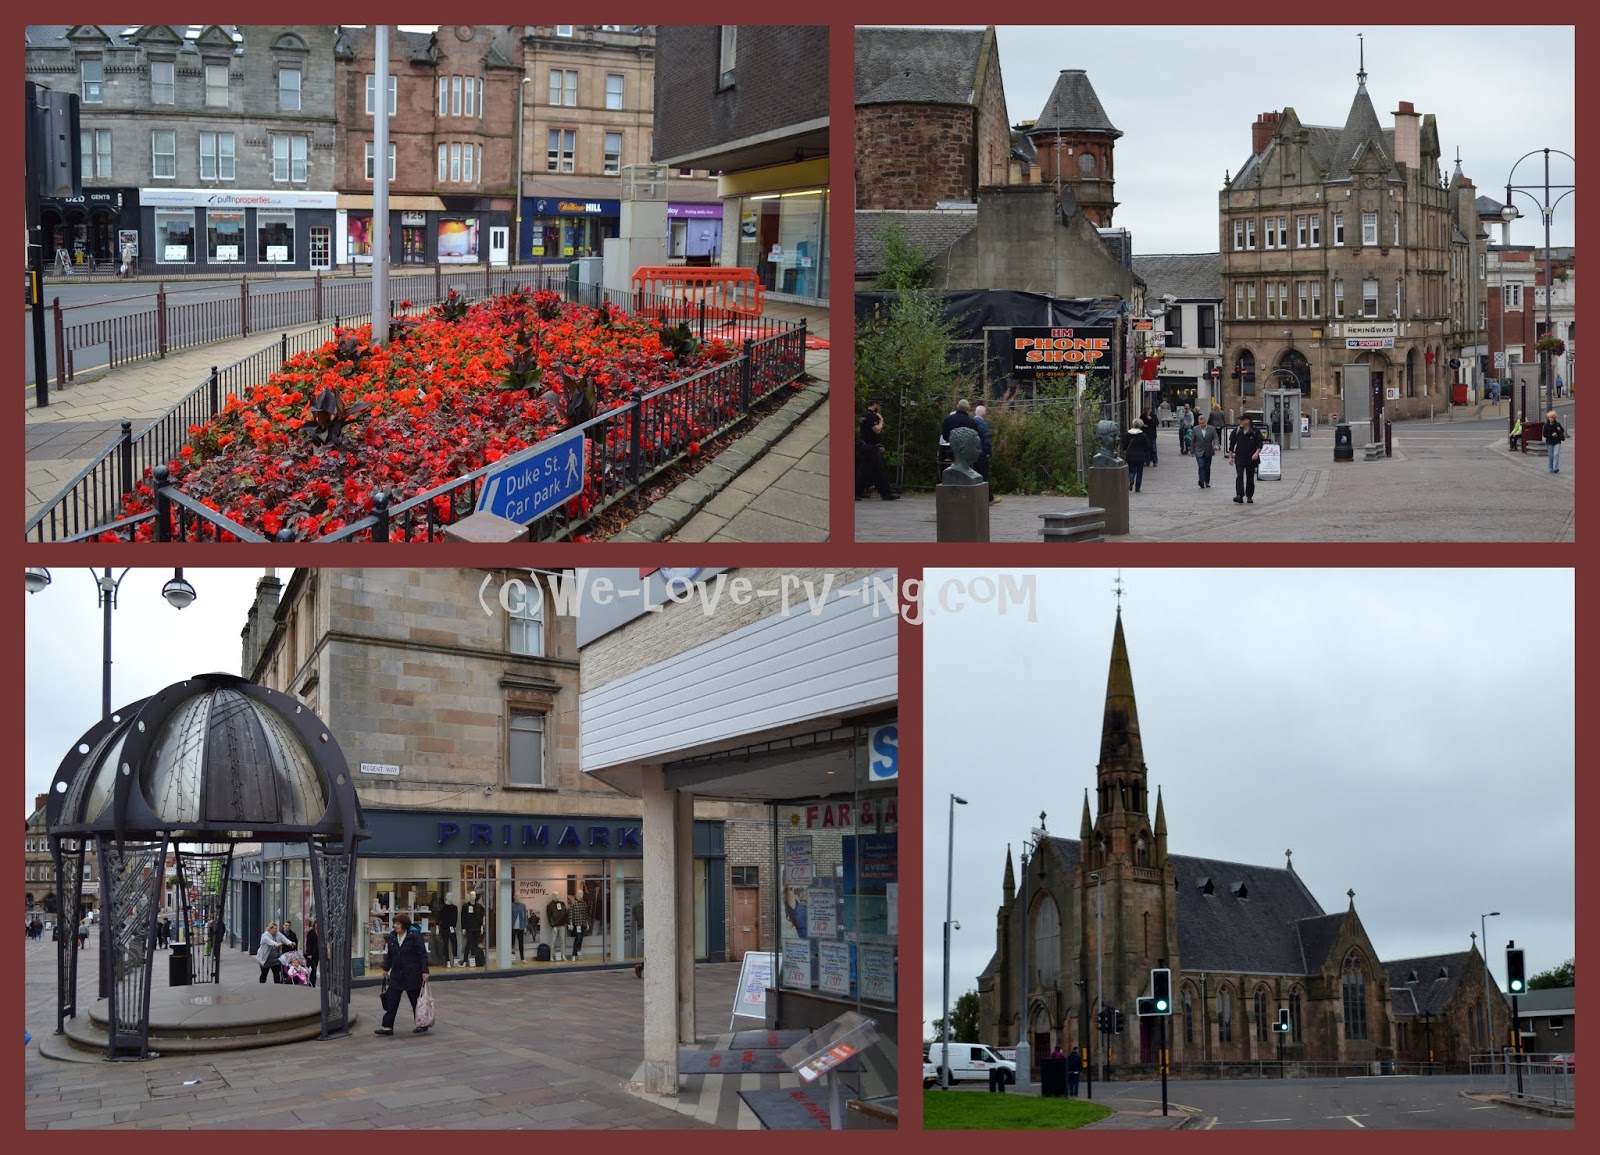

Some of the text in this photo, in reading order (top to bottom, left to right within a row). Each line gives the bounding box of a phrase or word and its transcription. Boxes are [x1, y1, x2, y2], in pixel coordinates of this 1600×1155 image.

[585, 203, 602, 212] HILL
[404, 211, 424, 220] 125
[1051, 328, 1074, 338] HM
[1014, 338, 1110, 350] PHONE
[1026, 350, 1104, 362] SHOP
[506, 455, 561, 496] Duke St.
[505, 479, 561, 520] Car park
[362, 764, 398, 774] REGENT WAY
[806, 803, 851, 829] FAR
[860, 802, 874, 825] &
[437, 822, 643, 848] PRIMARK
